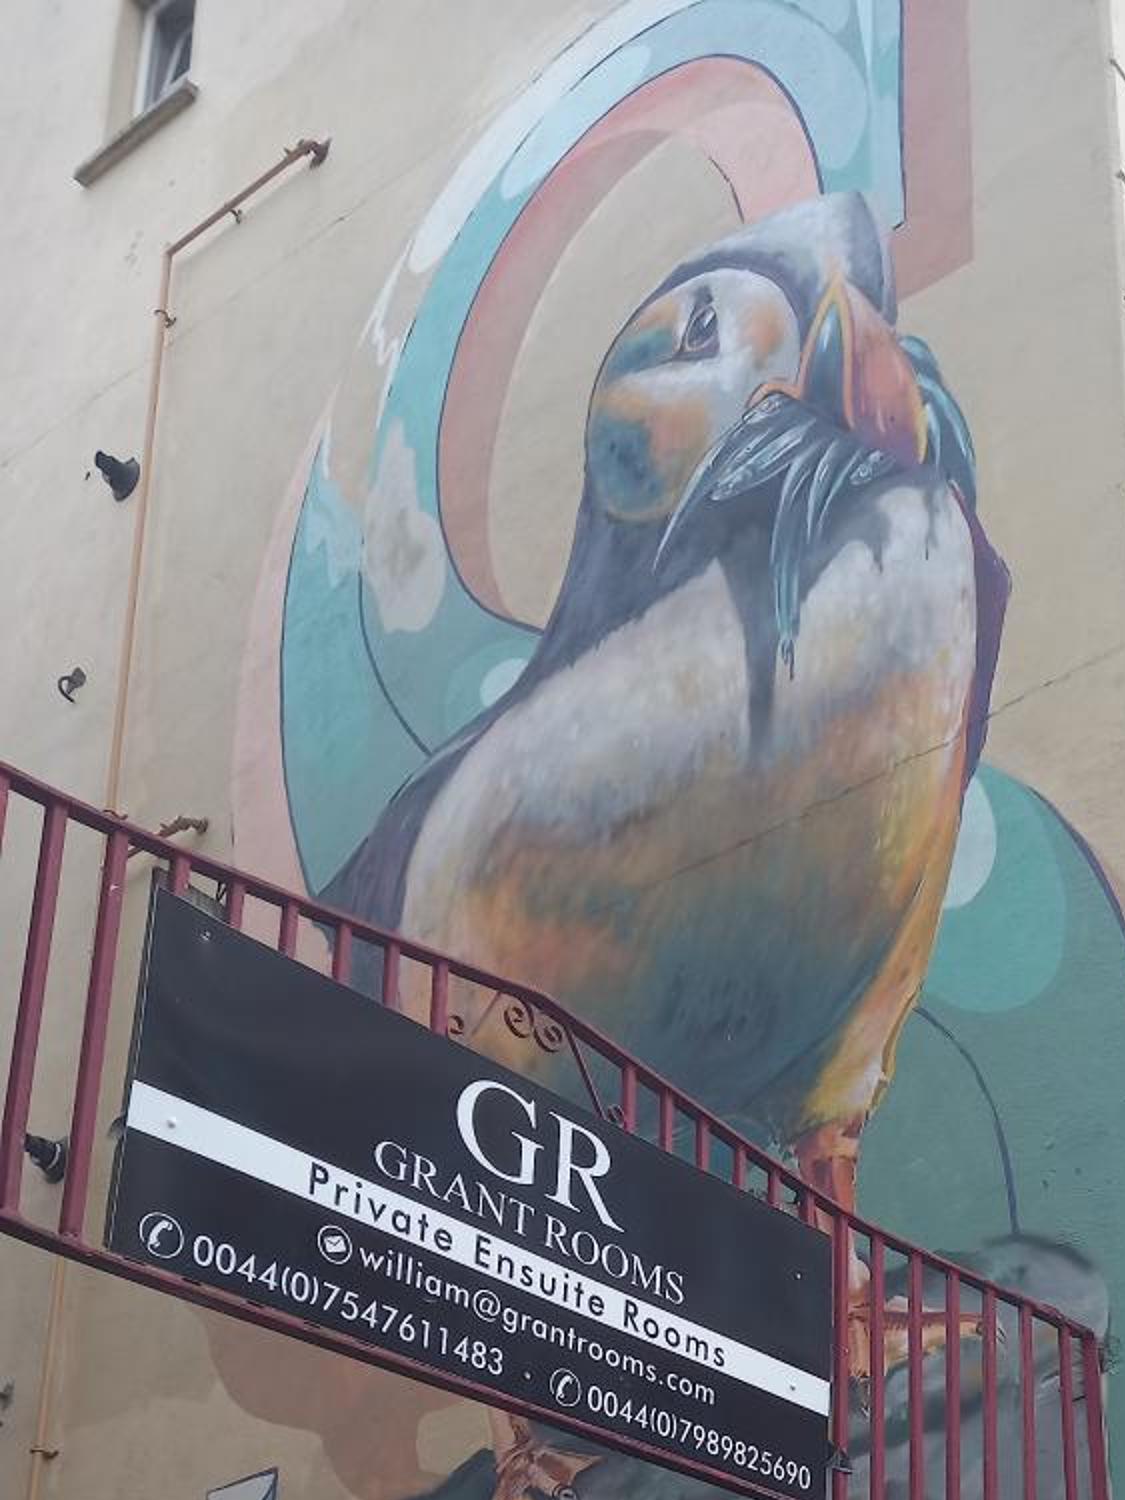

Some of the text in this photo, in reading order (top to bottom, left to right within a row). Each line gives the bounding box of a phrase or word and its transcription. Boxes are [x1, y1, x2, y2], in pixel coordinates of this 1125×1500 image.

[374, 1141, 685, 1305] GRANT ROOMS
[456, 1079, 625, 1232] GR
[308, 1161, 726, 1368] Private Ensuite Rooms
[359, 1247, 715, 1405] william@grantrooms.com
[193, 1235, 811, 1490] 0044(0)7547611483 0044(0)7989825690
